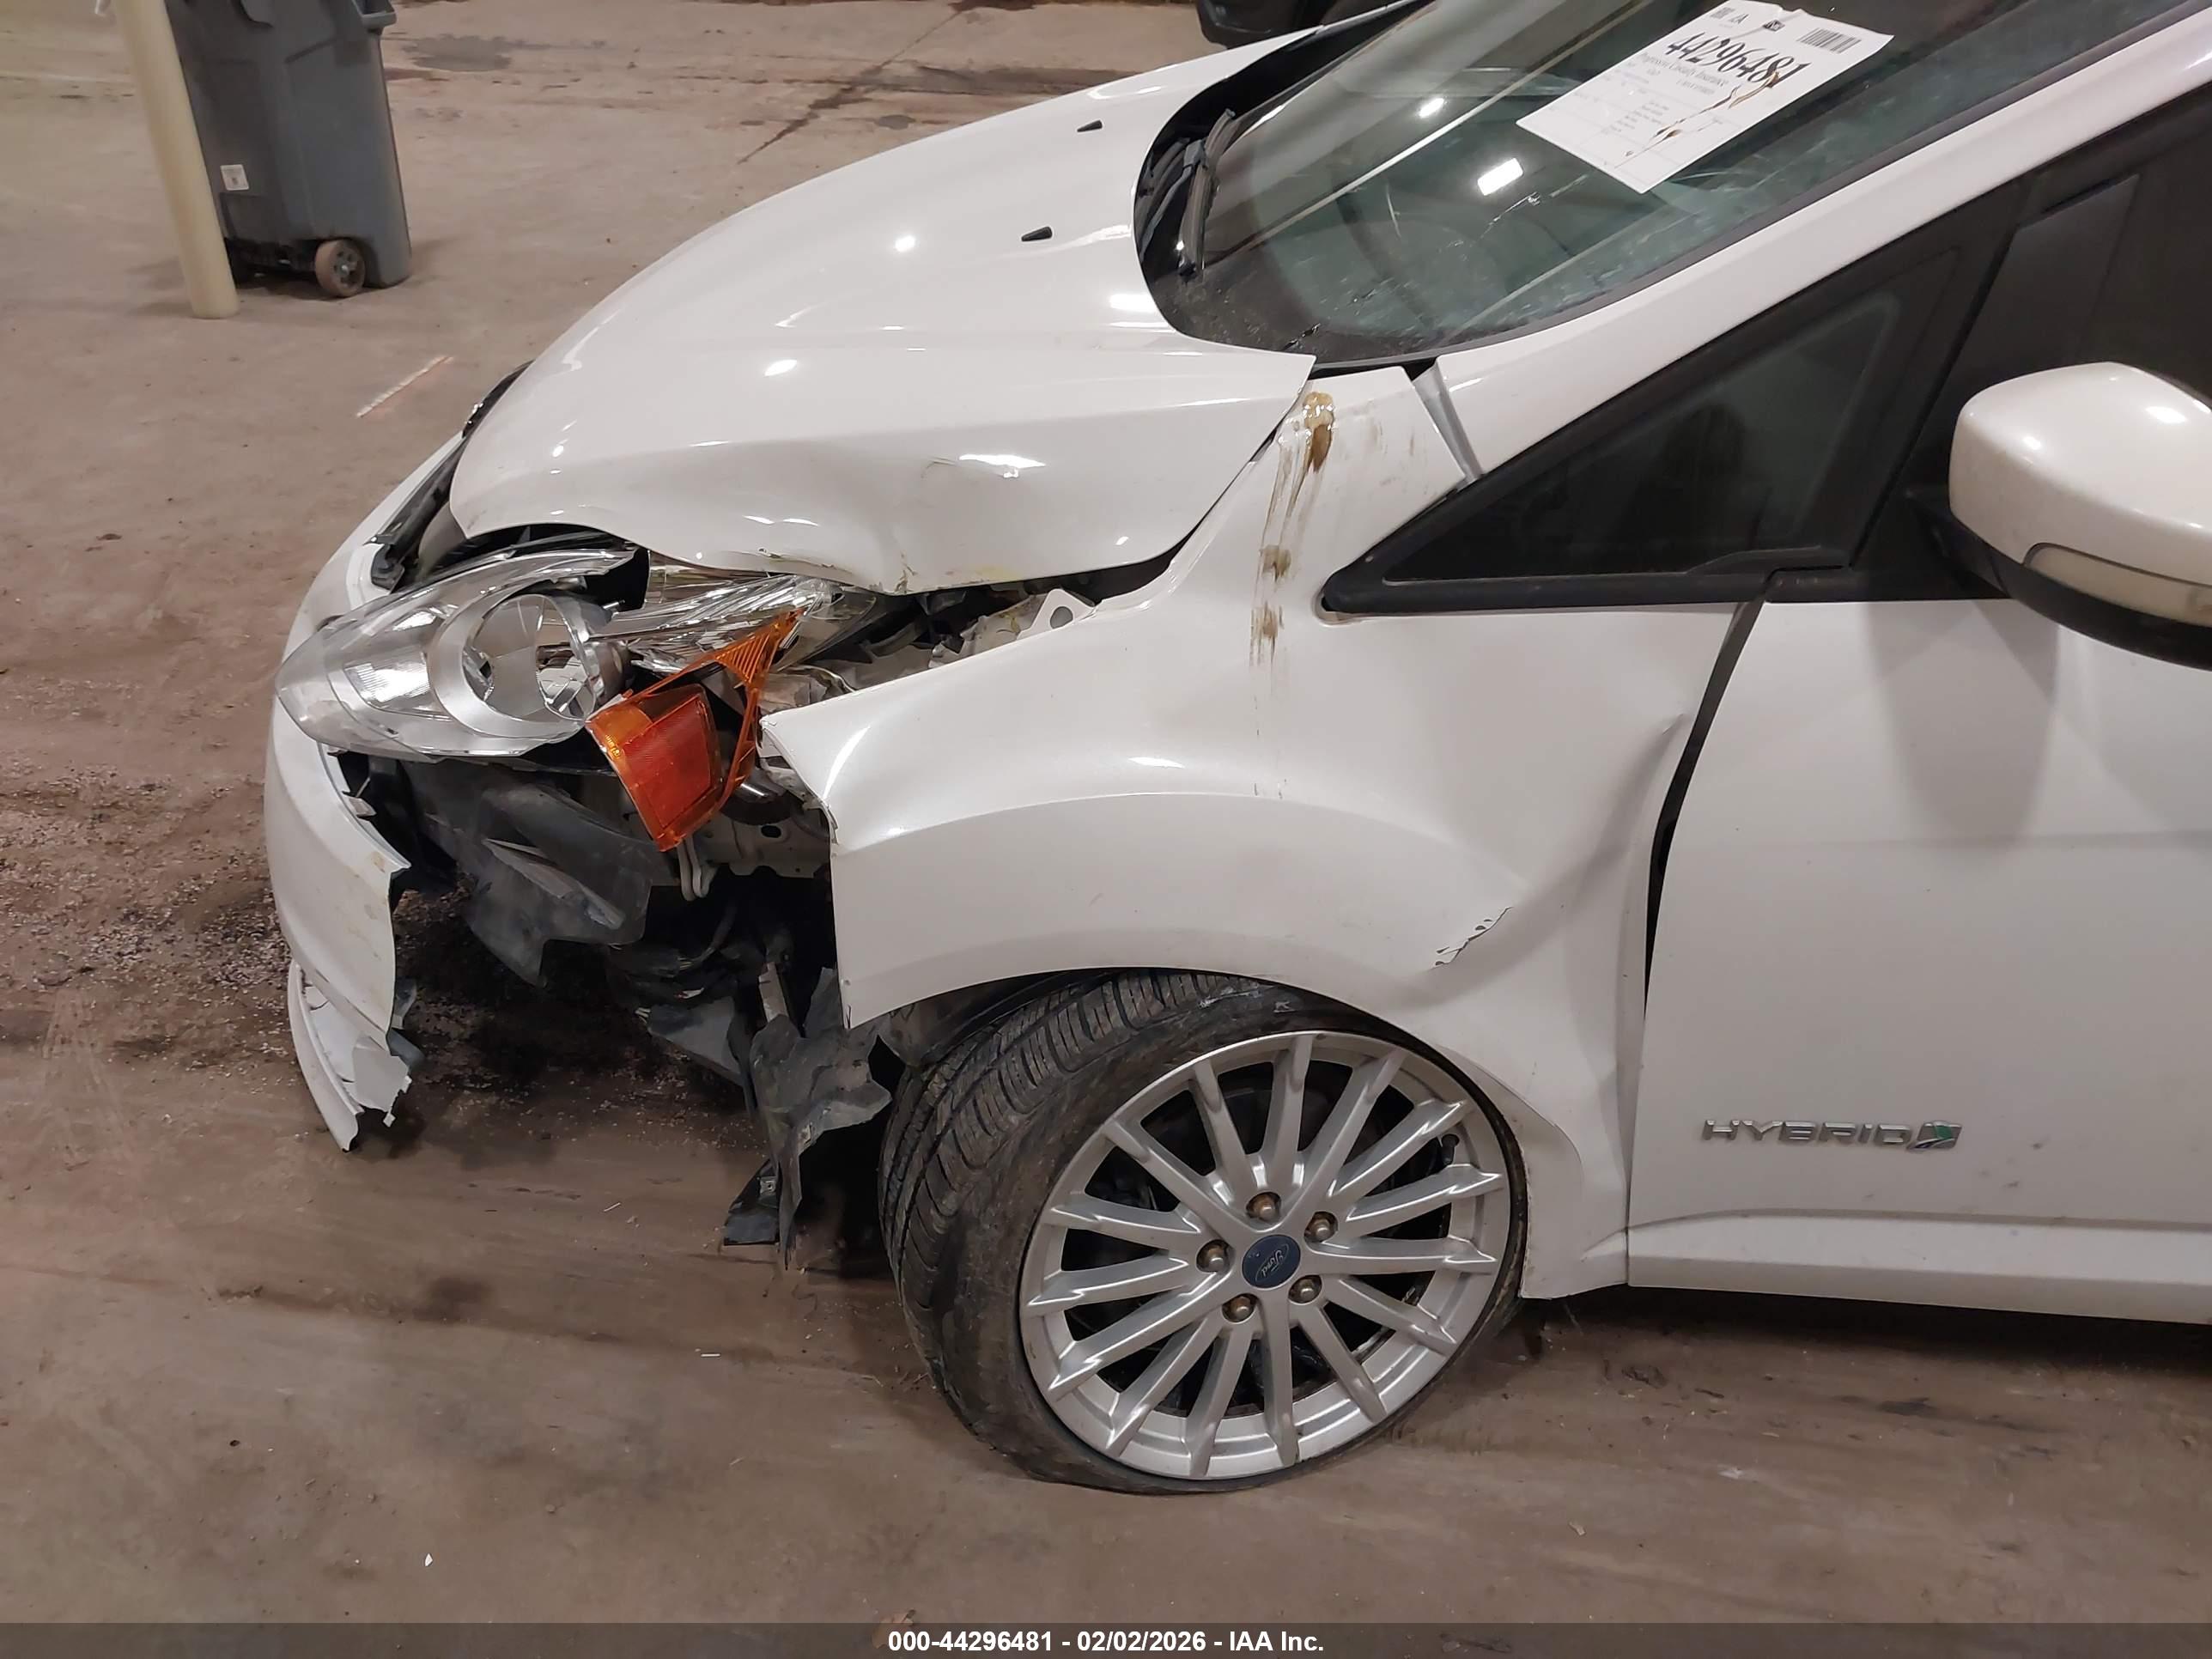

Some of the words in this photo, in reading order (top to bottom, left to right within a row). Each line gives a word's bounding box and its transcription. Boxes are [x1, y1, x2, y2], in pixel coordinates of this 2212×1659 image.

[1665, 32, 1811, 88] 44296481
[1701, 1119, 1911, 1148] HYBRID
[1261, 1249, 1285, 1277] Ford
